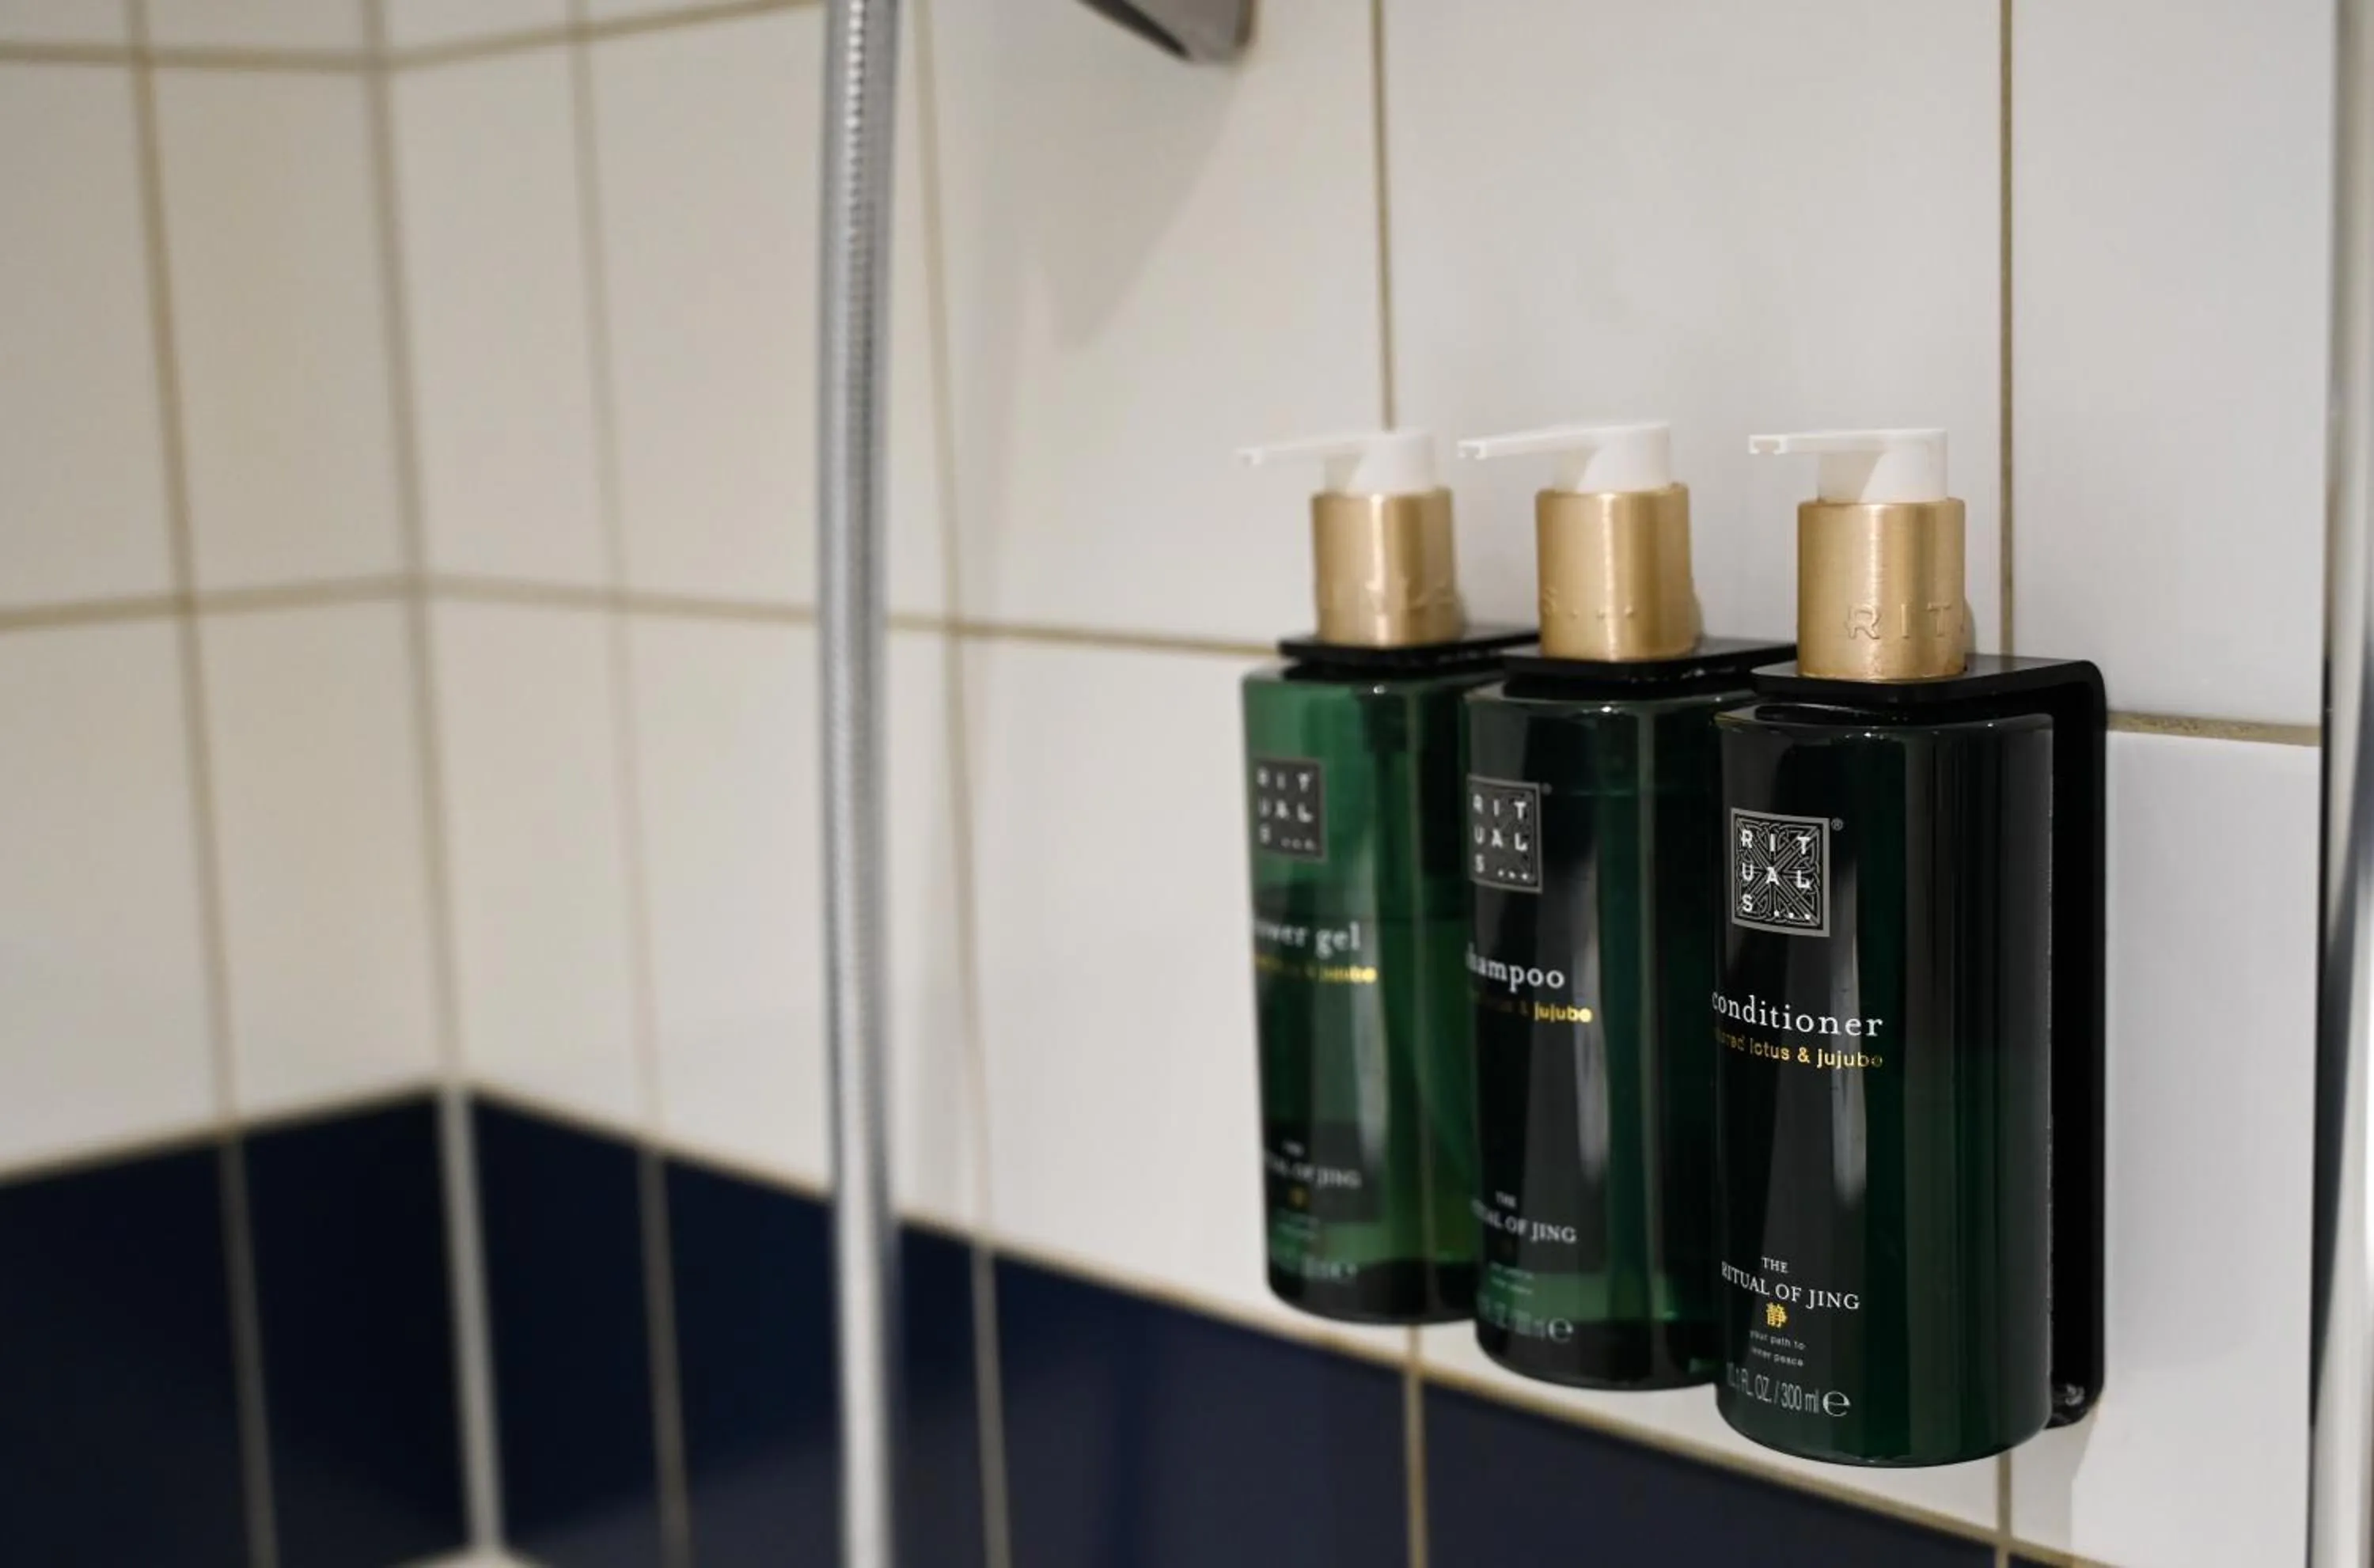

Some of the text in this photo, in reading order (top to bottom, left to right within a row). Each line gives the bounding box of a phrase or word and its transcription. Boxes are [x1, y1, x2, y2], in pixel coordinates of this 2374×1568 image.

[1473, 793, 1526, 818] RIT
[1473, 827, 1528, 851] UAL
[1742, 829, 1811, 855] RIT
[1742, 862, 1811, 888] UAL
[1315, 921, 1360, 960] gel
[1466, 941, 1565, 994] hampoo
[1712, 991, 1883, 1036] conditioner
[1750, 1038, 1790, 1061] lotus
[1797, 1047, 1811, 1064] &
[1817, 1048, 1883, 1070] jujube
[1530, 1222, 1577, 1244] JING
[1762, 1256, 1788, 1274] THE
[1721, 1260, 1860, 1310] RITUAL OF JING
[1780, 1382, 1802, 1411] 300
[1804, 1388, 1819, 1414] ml
